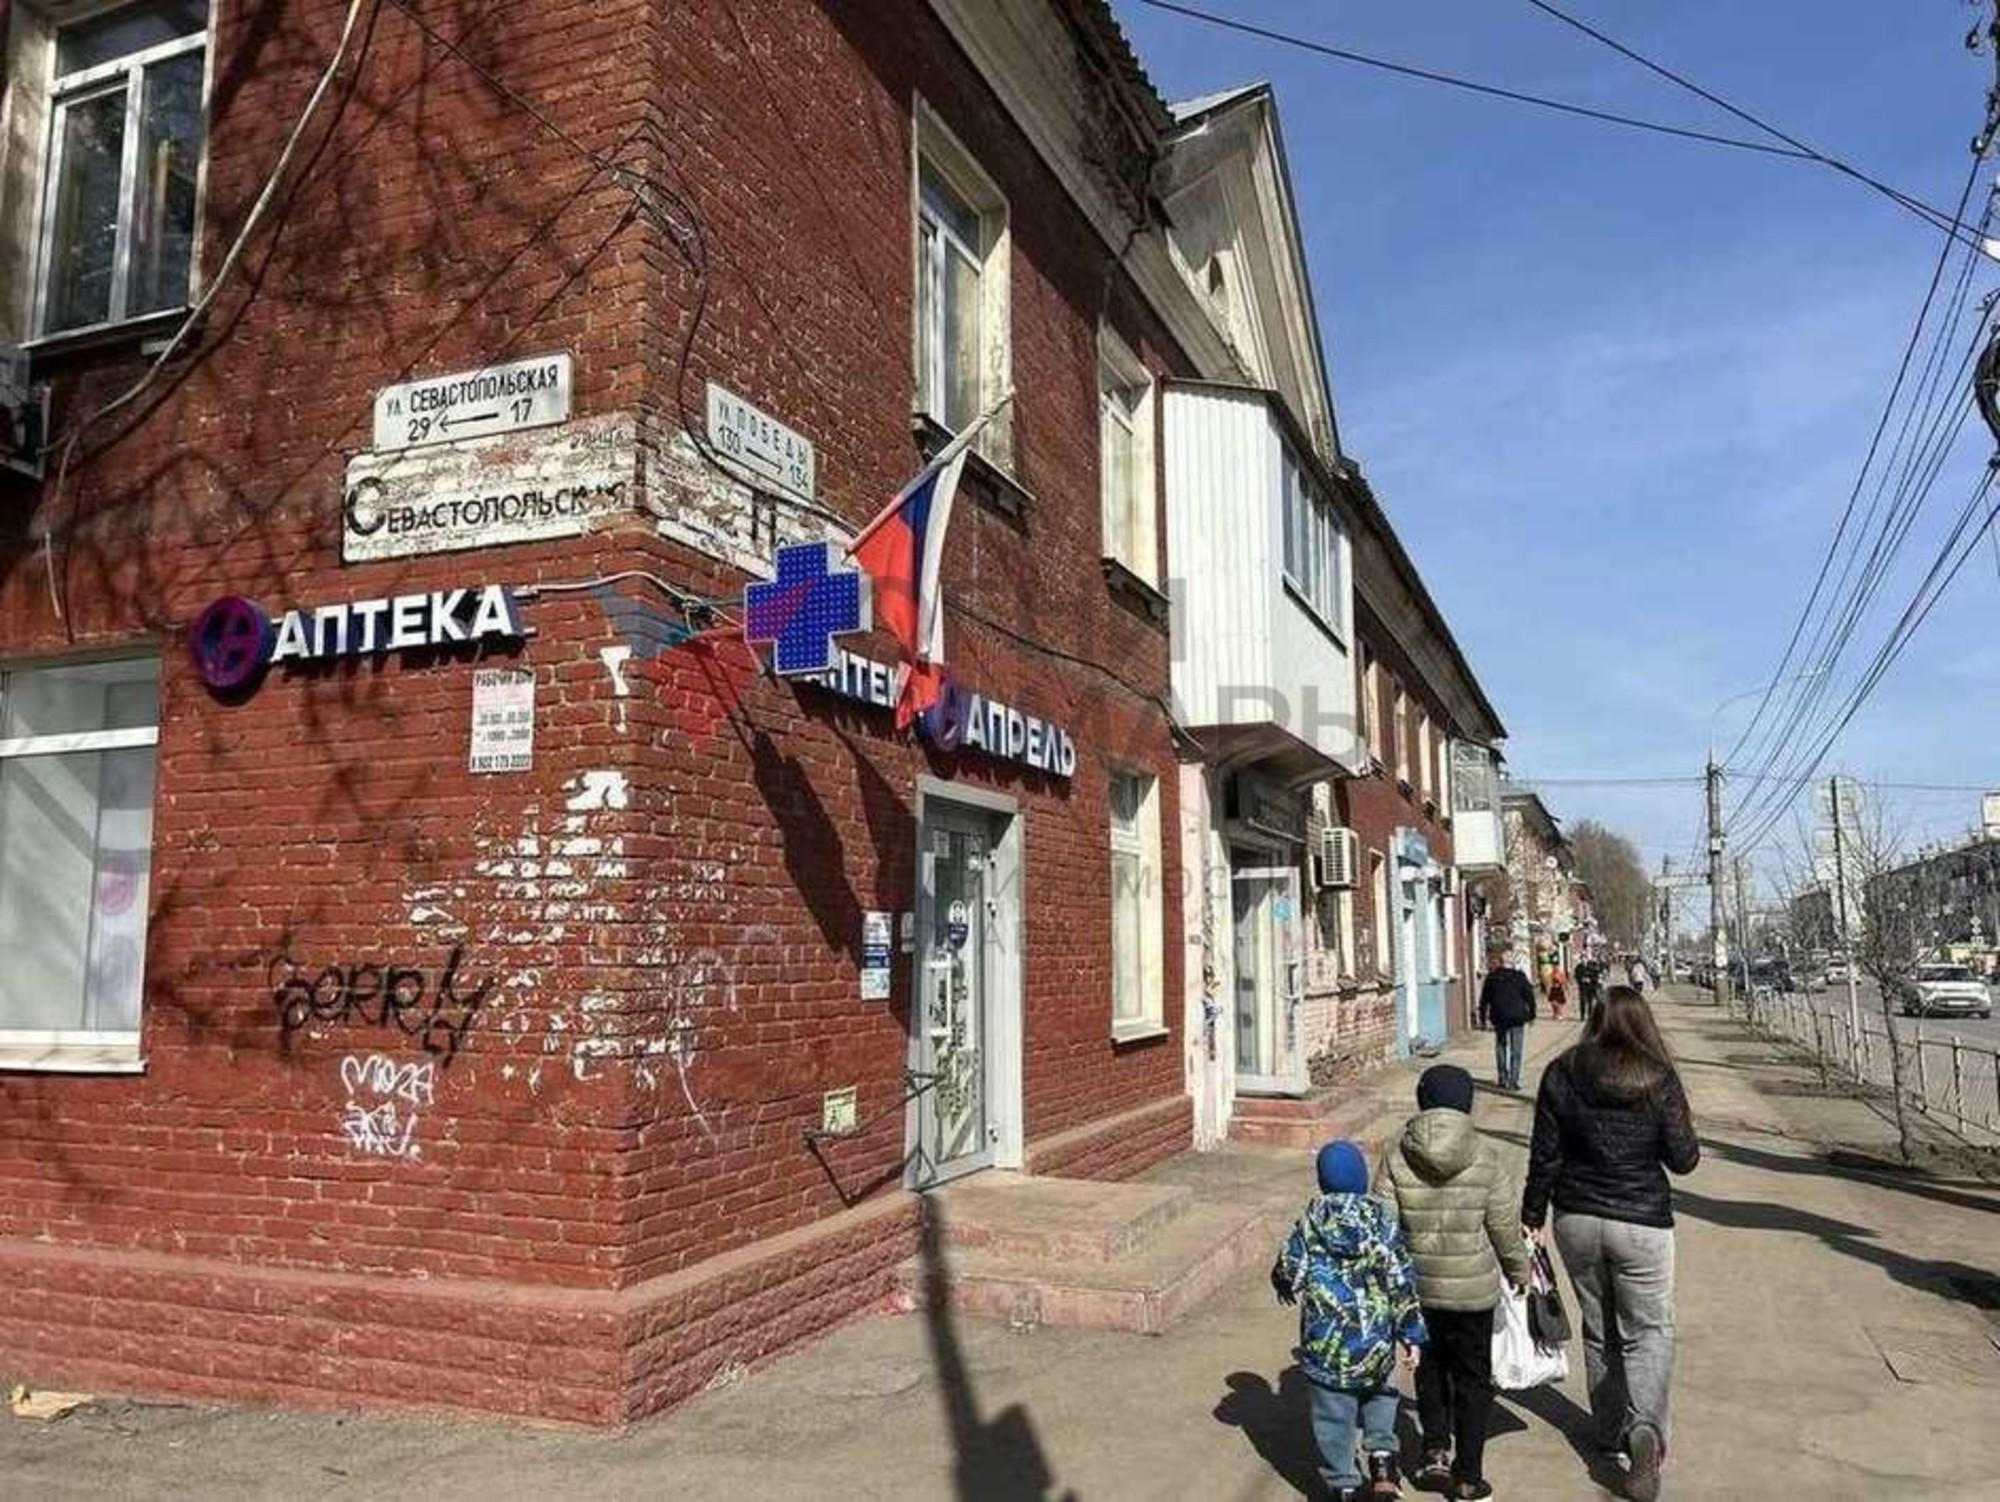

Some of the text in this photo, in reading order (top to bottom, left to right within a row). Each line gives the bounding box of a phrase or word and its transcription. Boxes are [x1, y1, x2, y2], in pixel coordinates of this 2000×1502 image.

[409, 364, 559, 415] СЕВАСТОПОЛЬСКАЯ
[407, 398, 533, 443] 29 17
[346, 476, 627, 537] СЕВАСТОПОЛЬСКЯ
[269, 584, 515, 662] АПТЕКА
[965, 694, 1076, 777] АПРЕЛЬ
